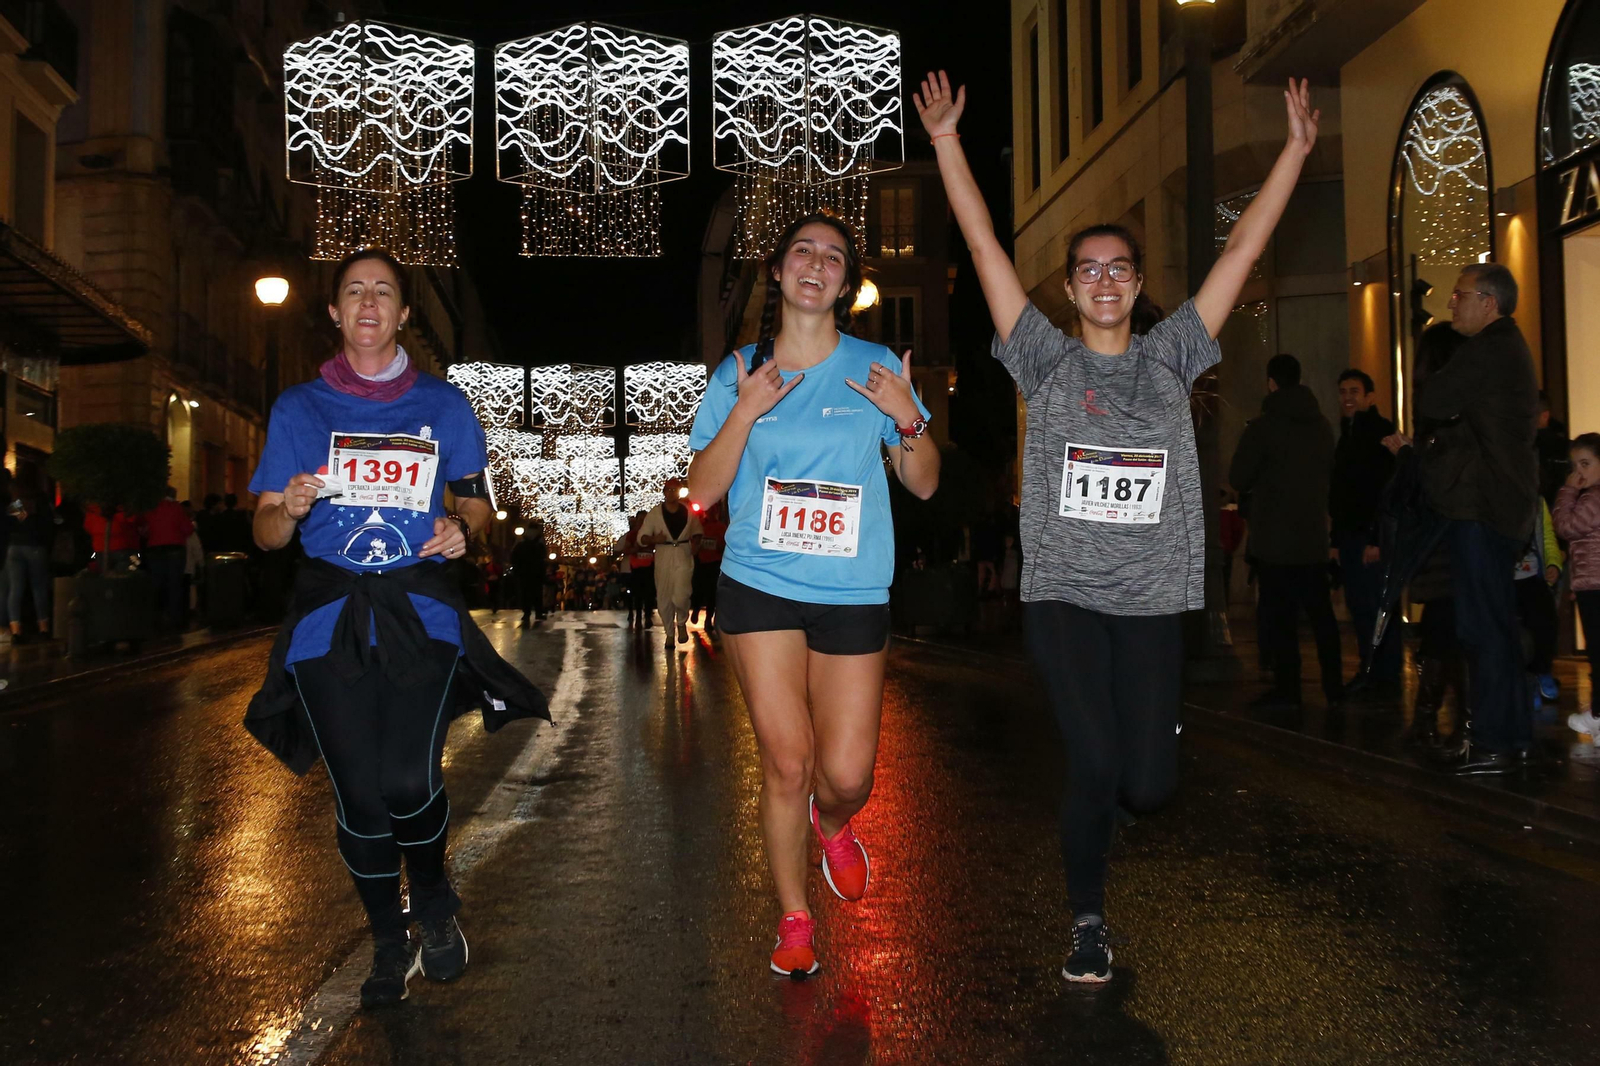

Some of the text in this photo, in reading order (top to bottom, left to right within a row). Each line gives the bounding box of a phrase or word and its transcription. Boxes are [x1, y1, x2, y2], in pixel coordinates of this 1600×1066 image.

[343, 458, 419, 487] 1391
[1076, 474, 1152, 502] 1187
[778, 506, 846, 536] 1186
